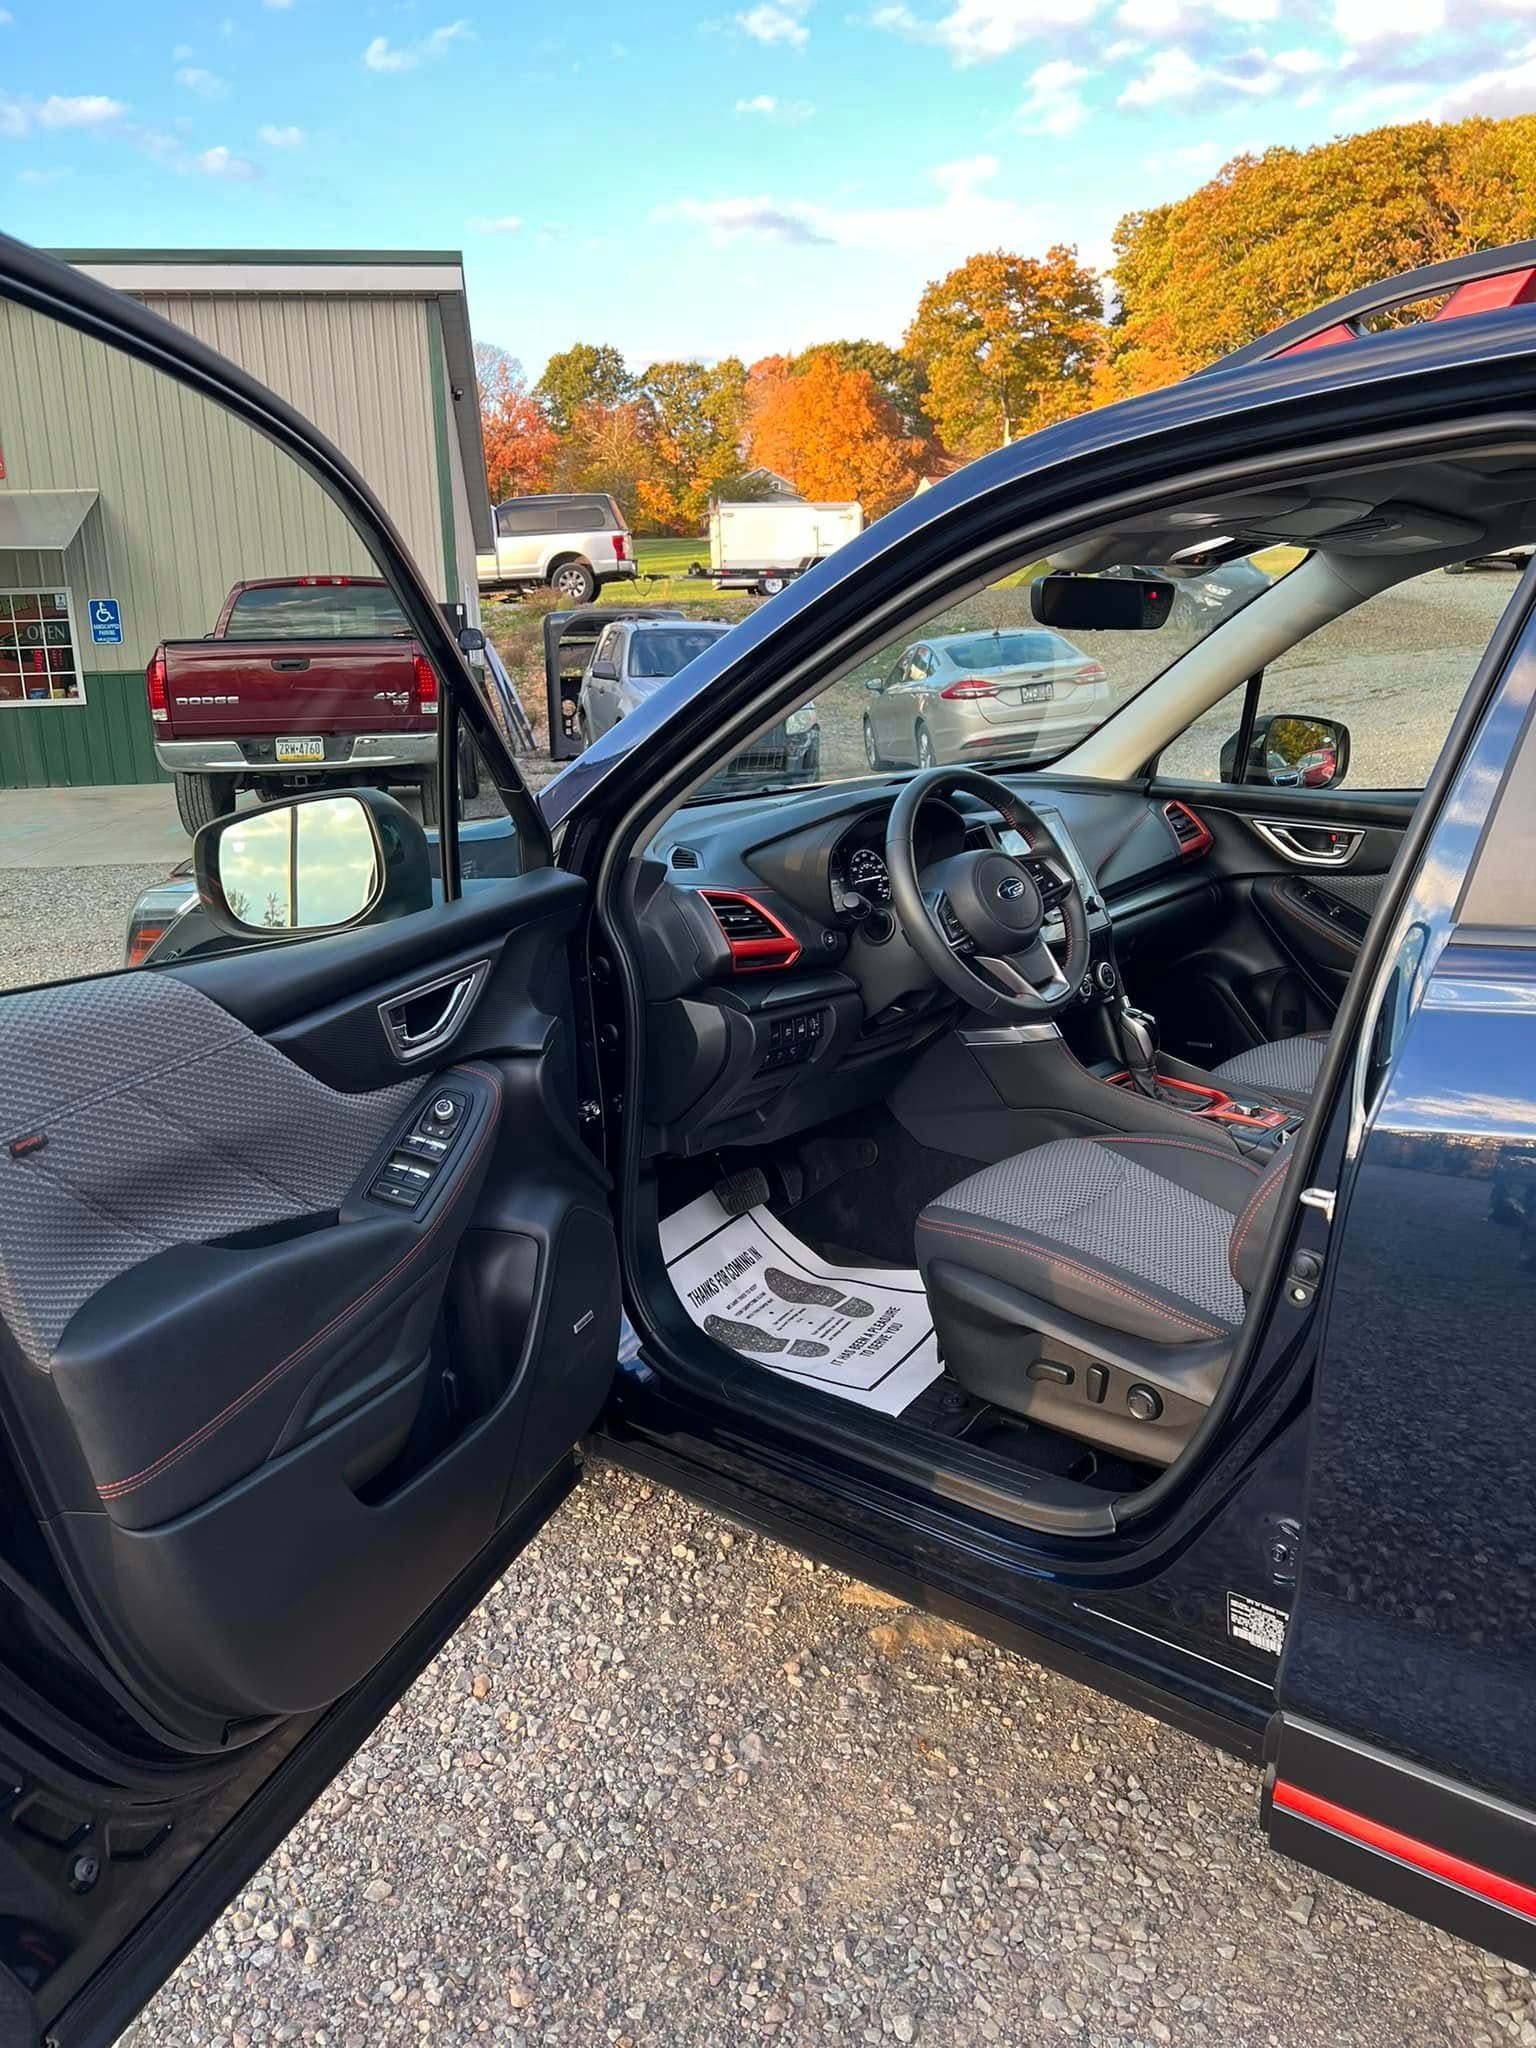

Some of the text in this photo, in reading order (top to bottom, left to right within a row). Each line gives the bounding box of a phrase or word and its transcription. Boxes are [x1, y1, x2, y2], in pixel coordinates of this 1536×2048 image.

[27, 625, 65, 640] OPEN
[175, 696, 240, 706] DODGE
[687, 1277, 720, 1309] THANKS
[713, 1269, 733, 1290] FOR
[724, 1251, 756, 1281] COMING
[747, 1246, 763, 1262] IN
[866, 1306, 901, 1334] PLEASURE
[848, 1336, 872, 1351] BEEN
[859, 1321, 904, 1358] TO SERVE YOU
[836, 1349, 857, 1361] HAS
[830, 1359, 845, 1367] IT
